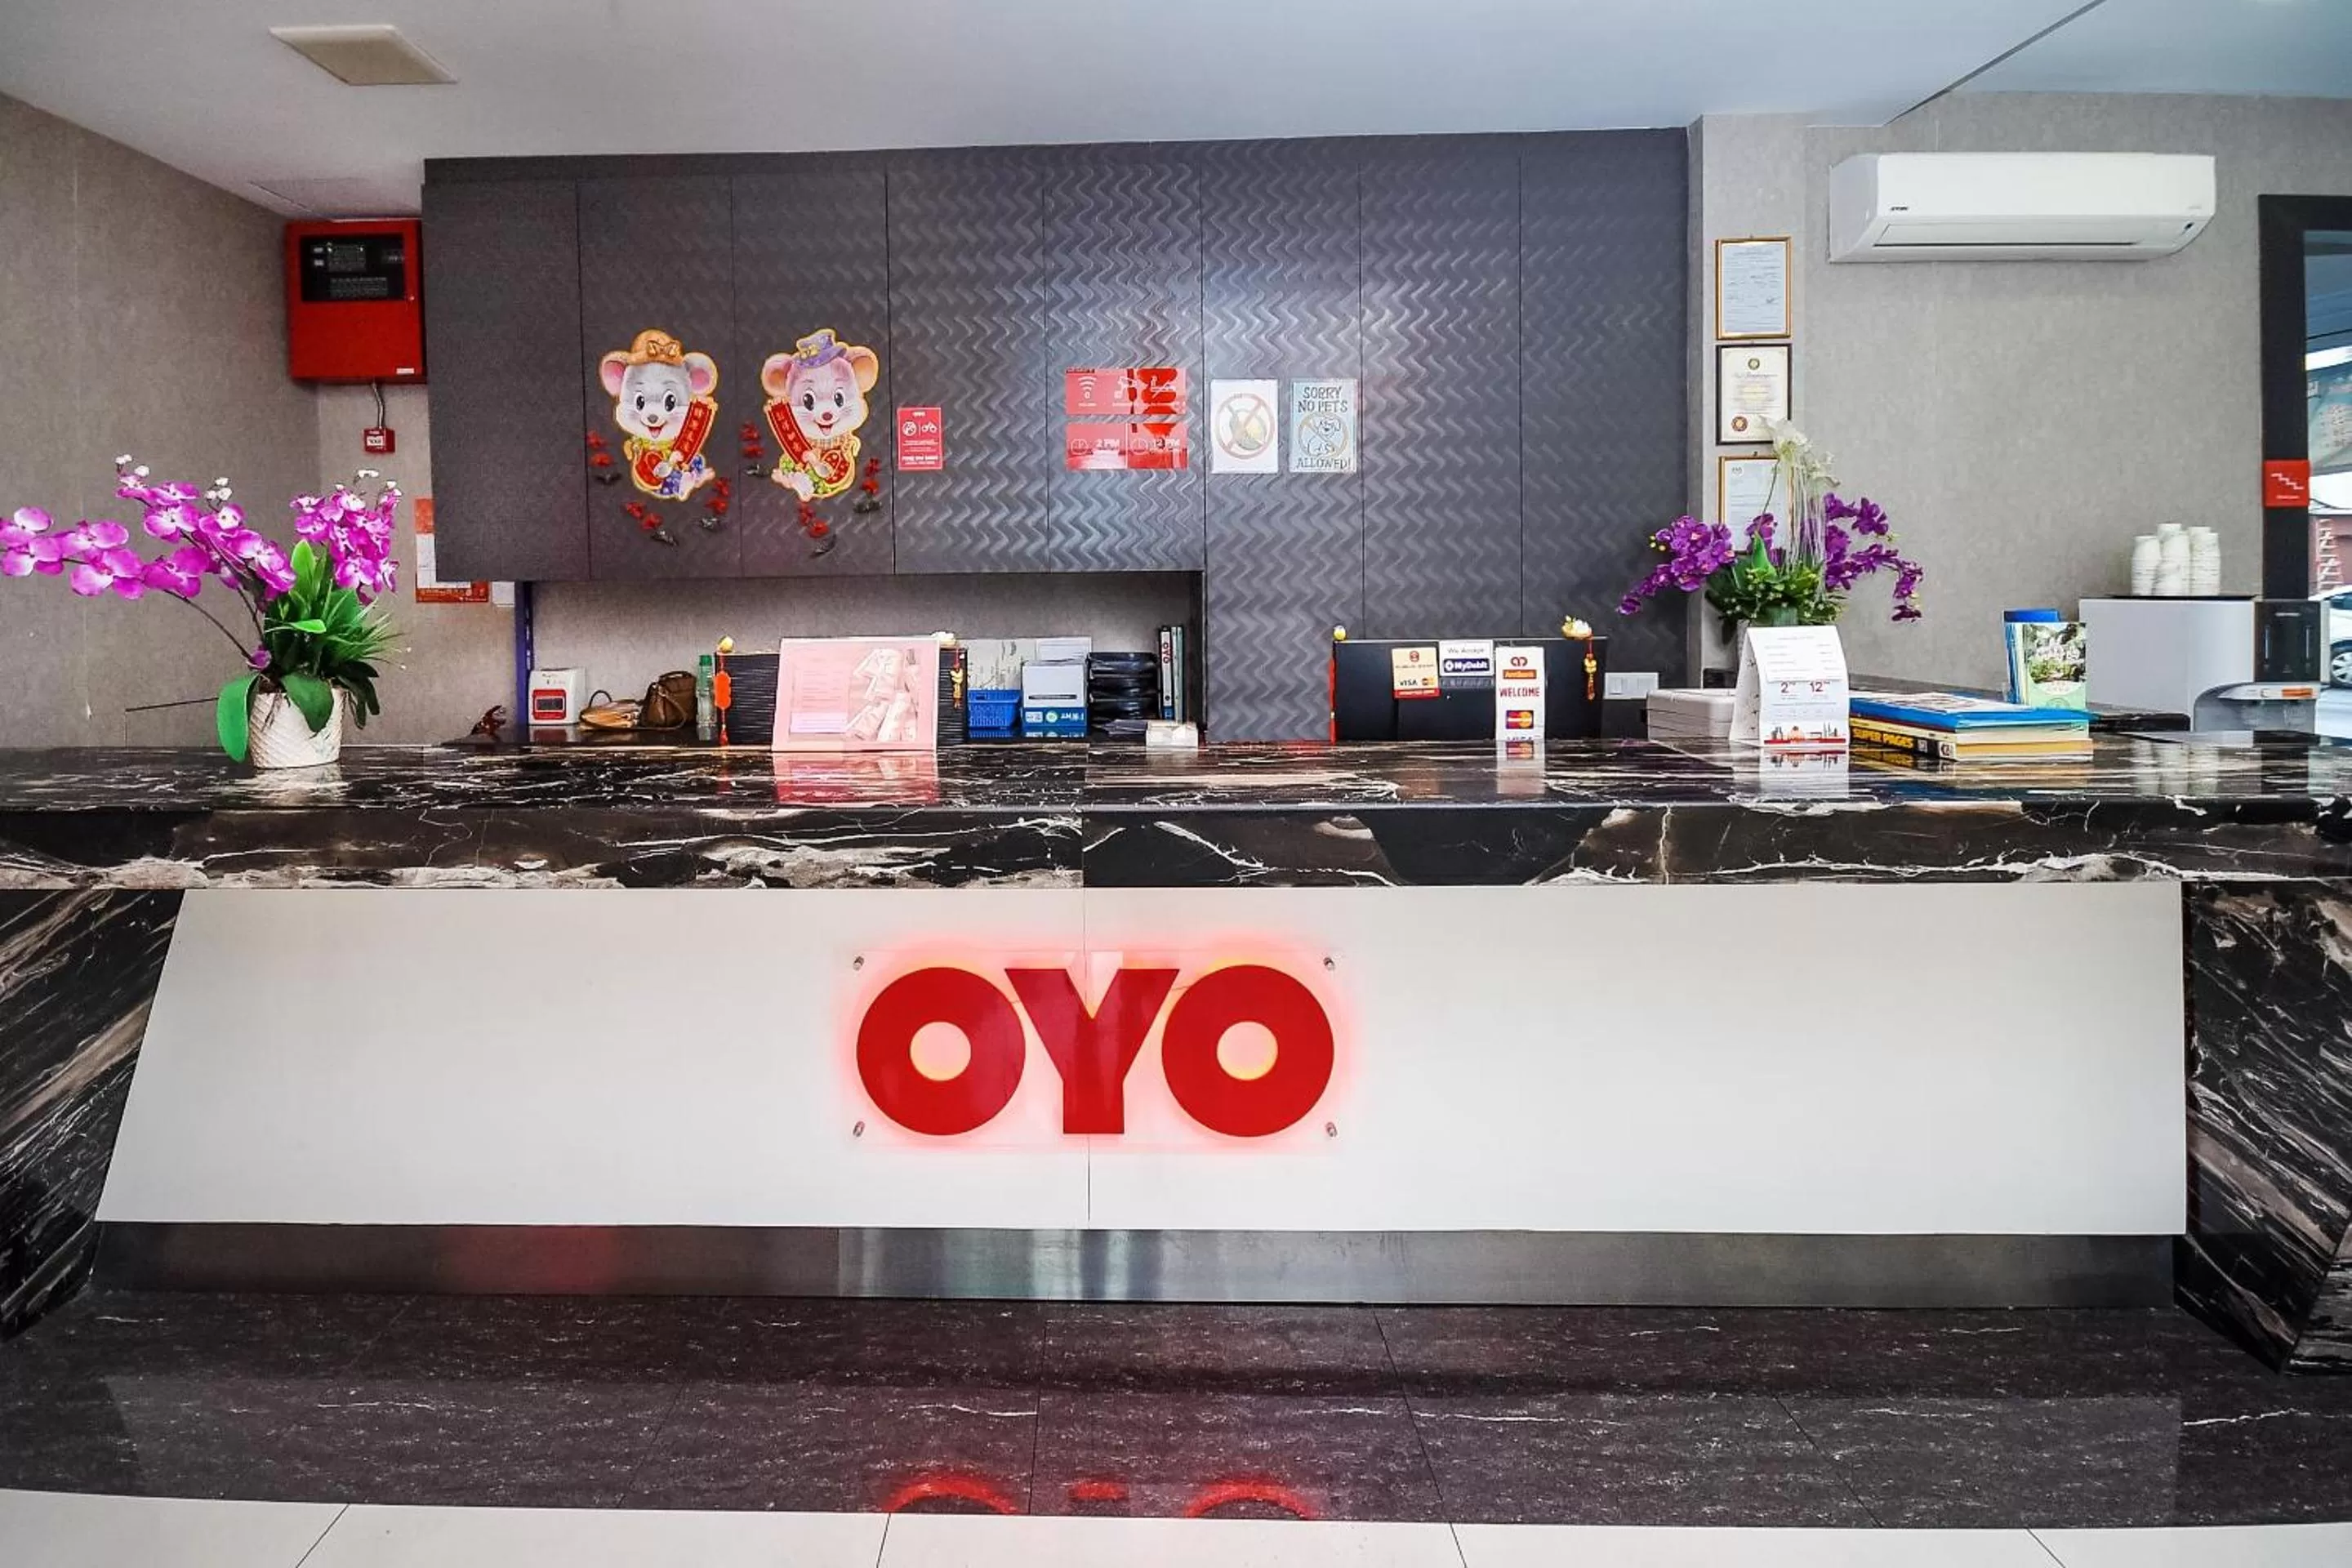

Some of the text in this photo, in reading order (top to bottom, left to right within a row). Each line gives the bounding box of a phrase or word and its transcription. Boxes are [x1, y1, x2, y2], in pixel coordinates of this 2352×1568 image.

[1303, 386, 1342, 399] SORRY
[1298, 399, 1348, 412] NO PETS
[1400, 679, 1419, 687] VISA
[1499, 687, 1540, 697] WELCOME
[1852, 728, 1882, 742] SUPER
[1882, 733, 1914, 749] PAGES
[857, 965, 1334, 1138] OYO
